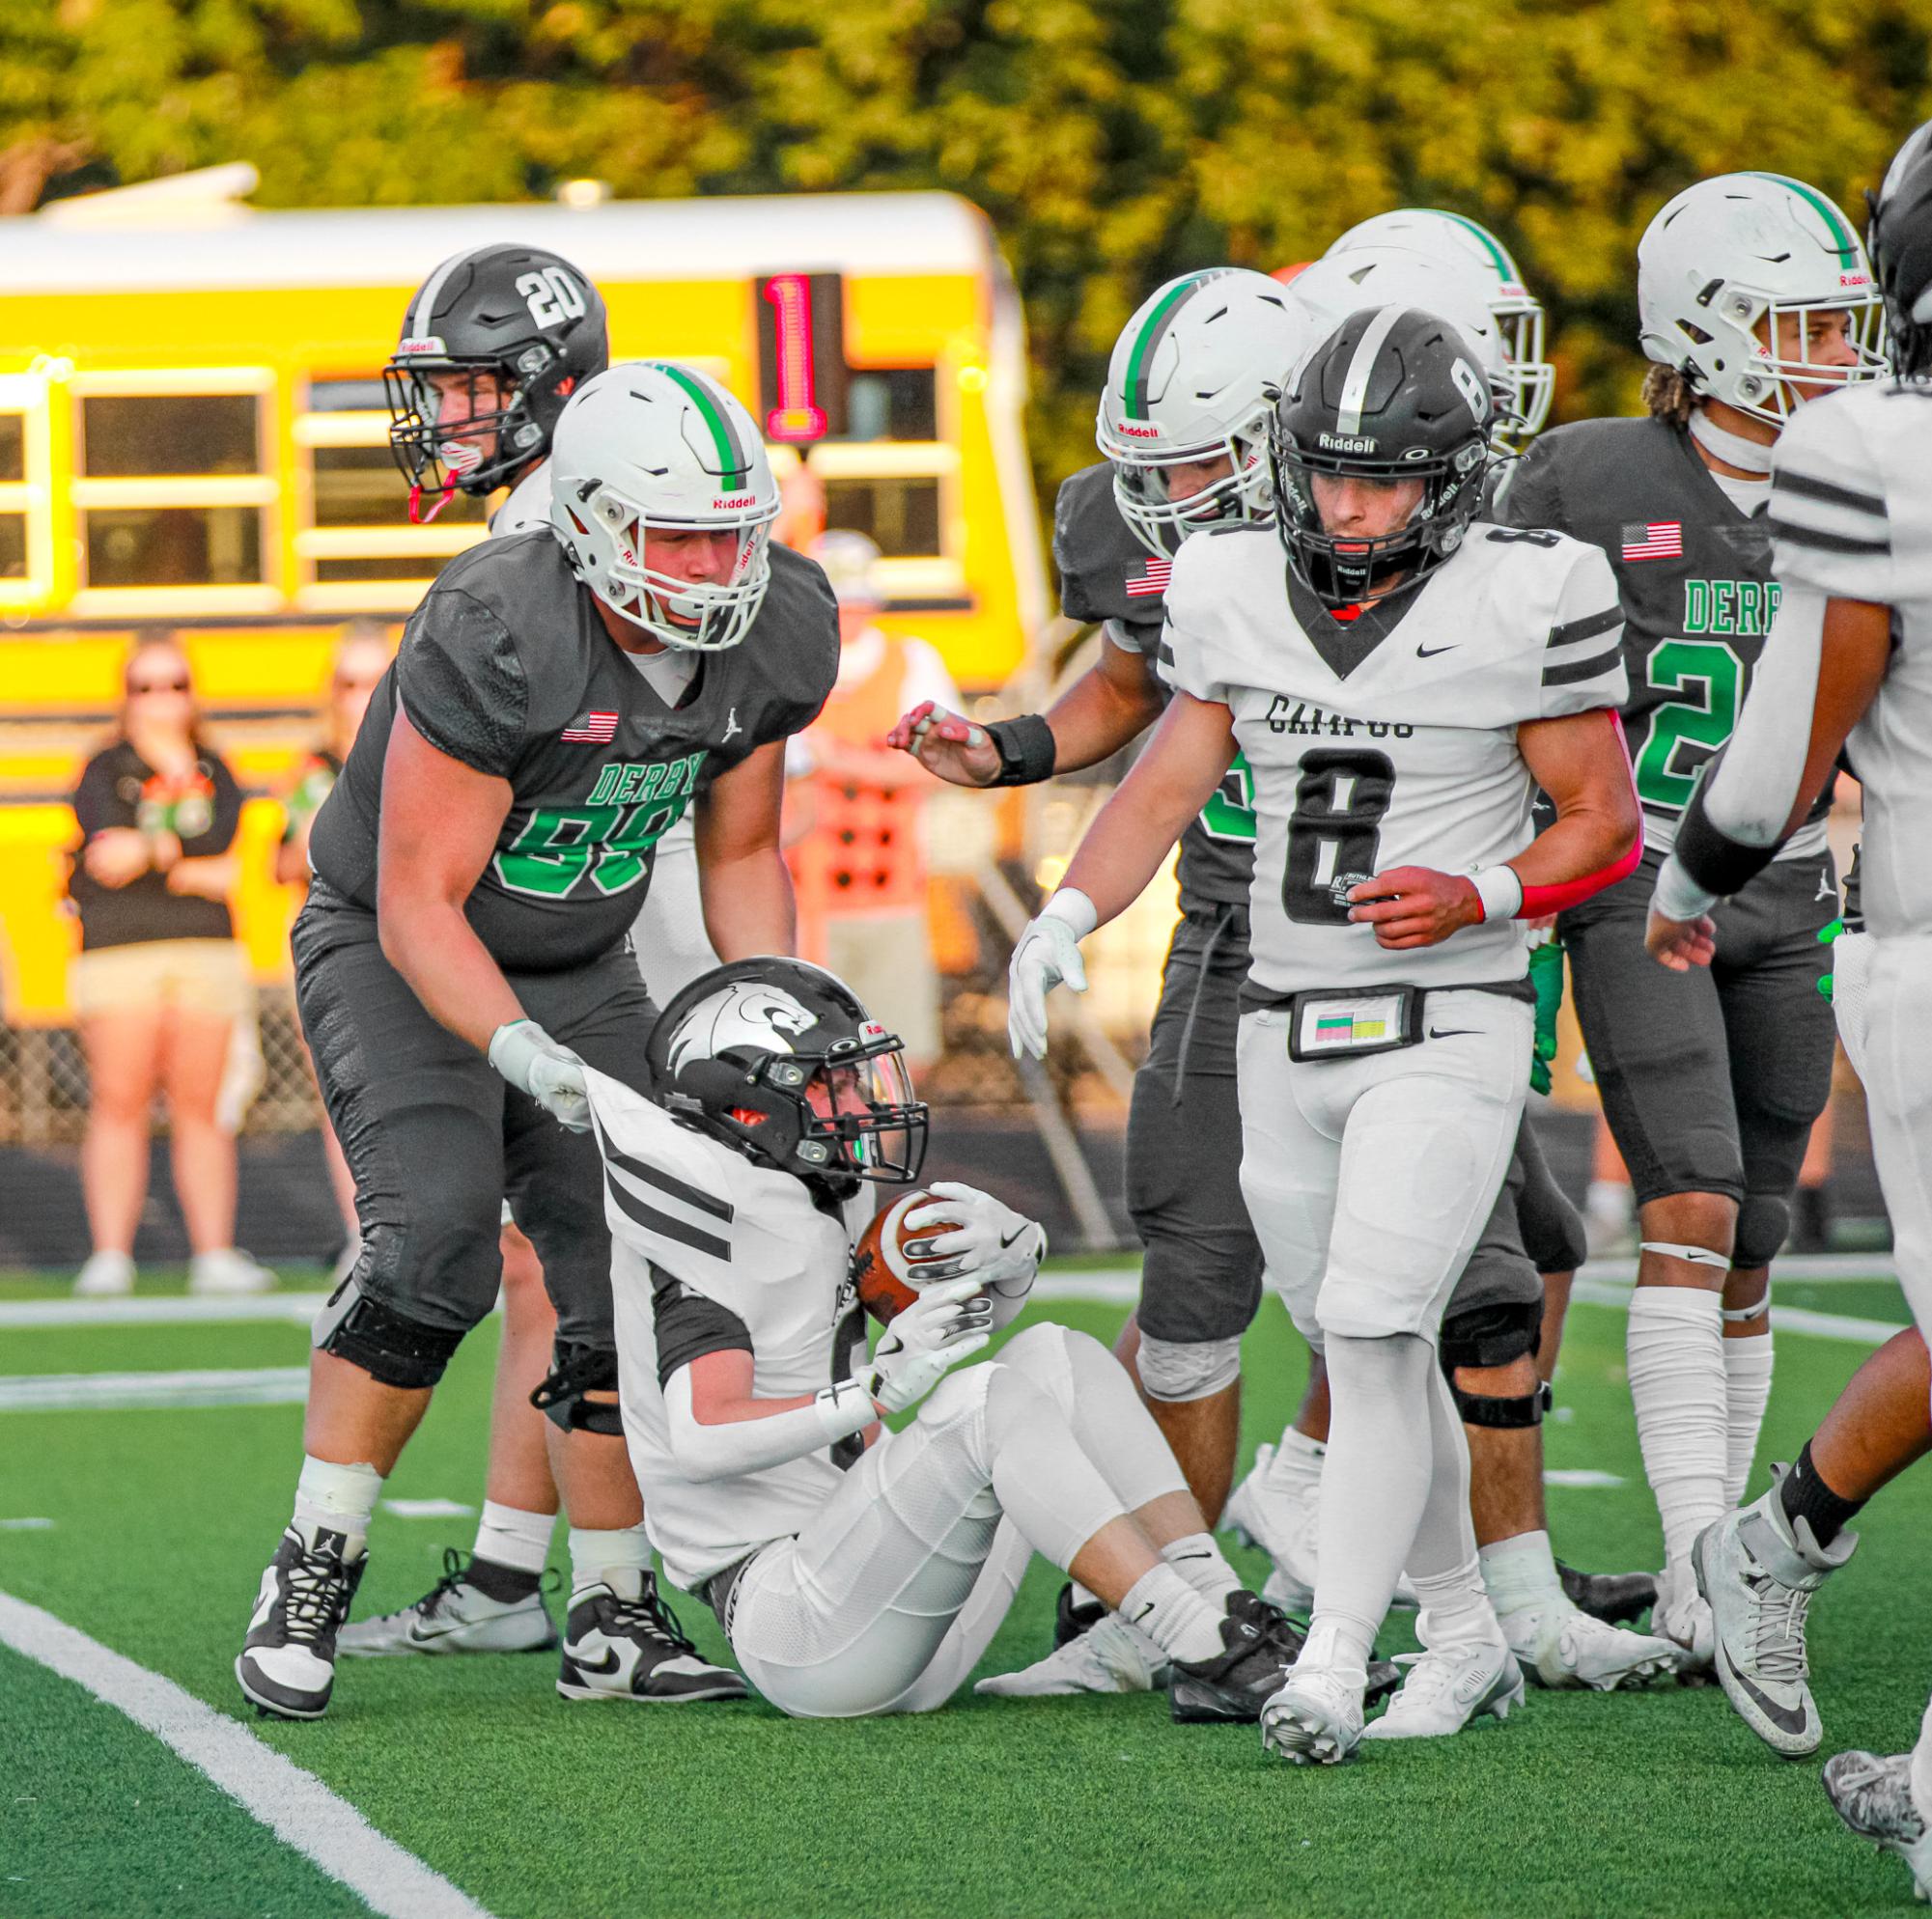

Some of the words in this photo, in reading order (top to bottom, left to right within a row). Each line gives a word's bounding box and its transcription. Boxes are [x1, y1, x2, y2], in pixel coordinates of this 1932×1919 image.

[515, 266, 587, 330] 20
[764, 273, 827, 440] 1
[1451, 357, 1489, 423] 8
[1118, 423, 1159, 438] Riddell
[1319, 434, 1375, 454] Riddell
[713, 495, 756, 510] Riddell
[1683, 578, 1783, 636] DER
[1634, 637, 1761, 811] 2
[585, 750, 710, 806] DERBY
[1281, 747, 1396, 925] 8
